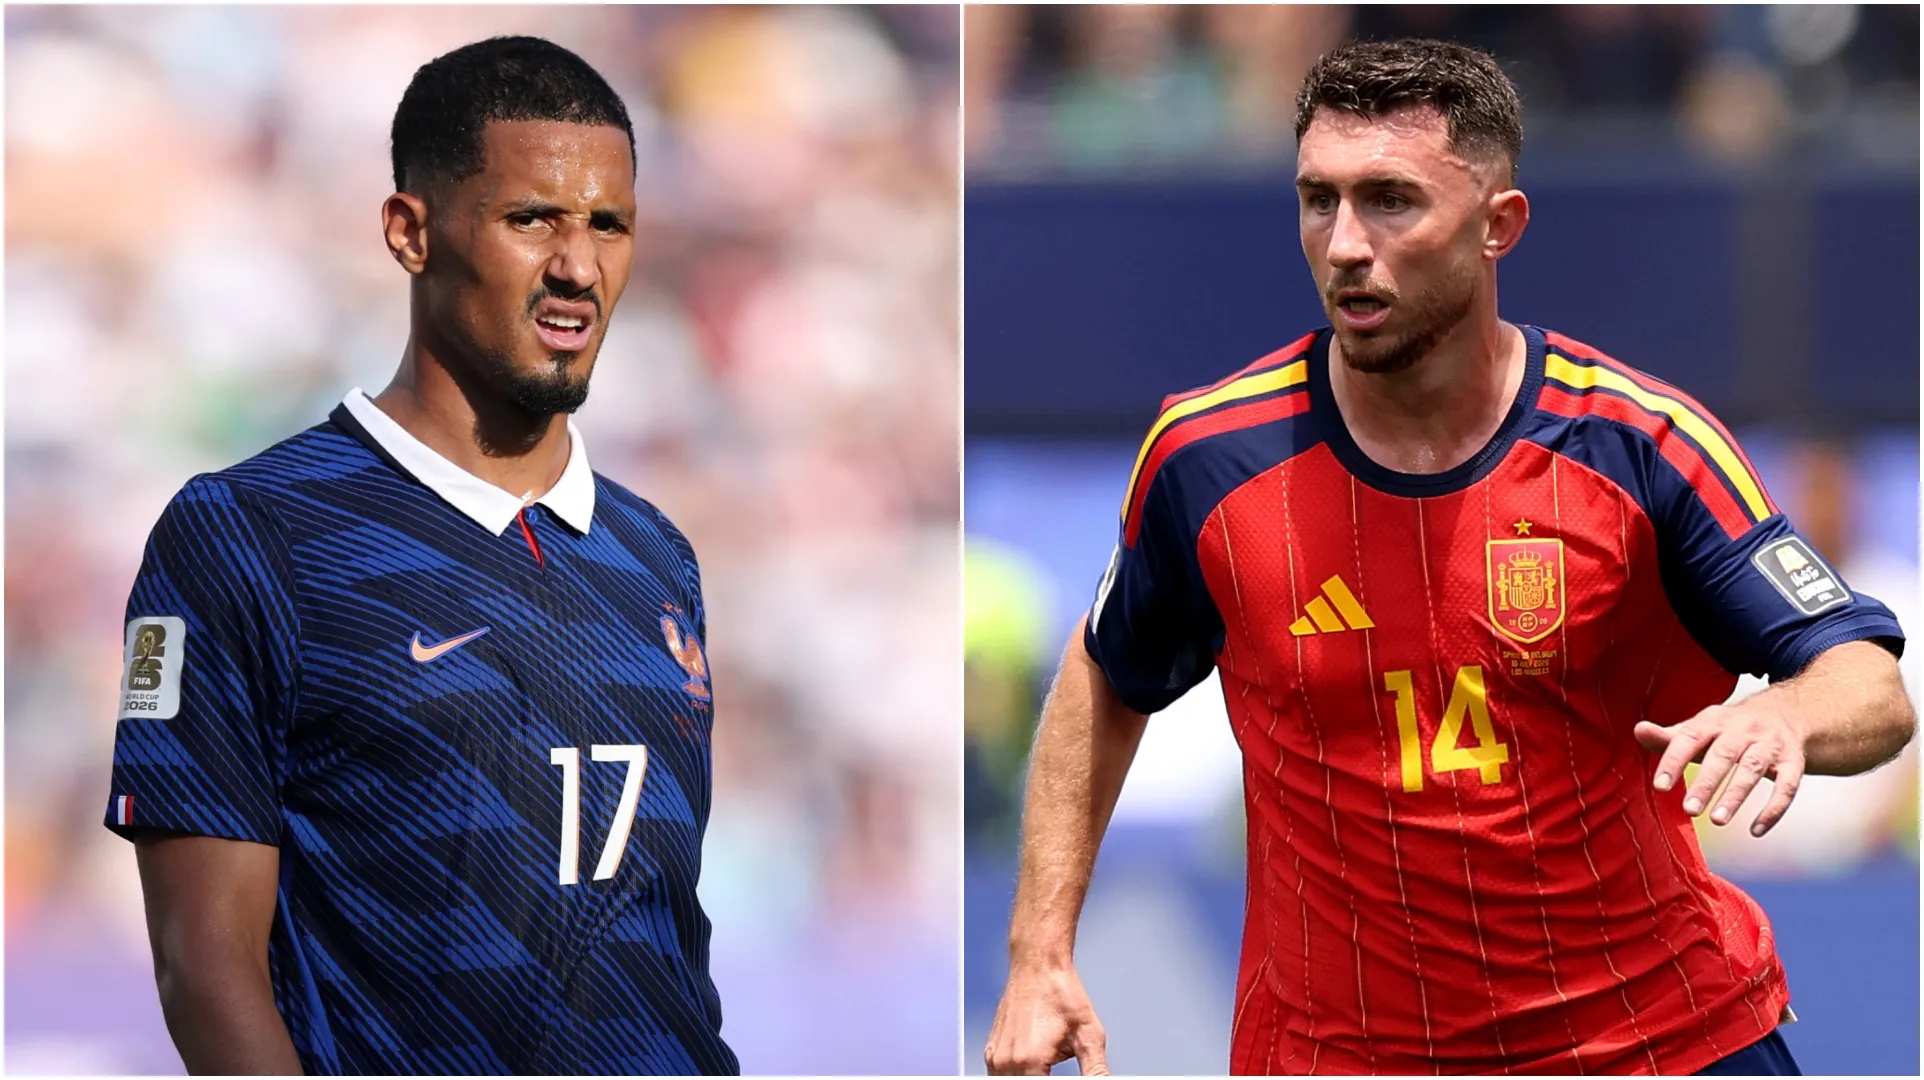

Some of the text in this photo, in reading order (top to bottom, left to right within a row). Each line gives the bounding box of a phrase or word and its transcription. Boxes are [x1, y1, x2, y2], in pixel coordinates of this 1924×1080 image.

[124, 701, 158, 710] 2026
[134, 677, 152, 685] FIFA
[1384, 665, 1509, 793] 14
[551, 744, 648, 886] 17
